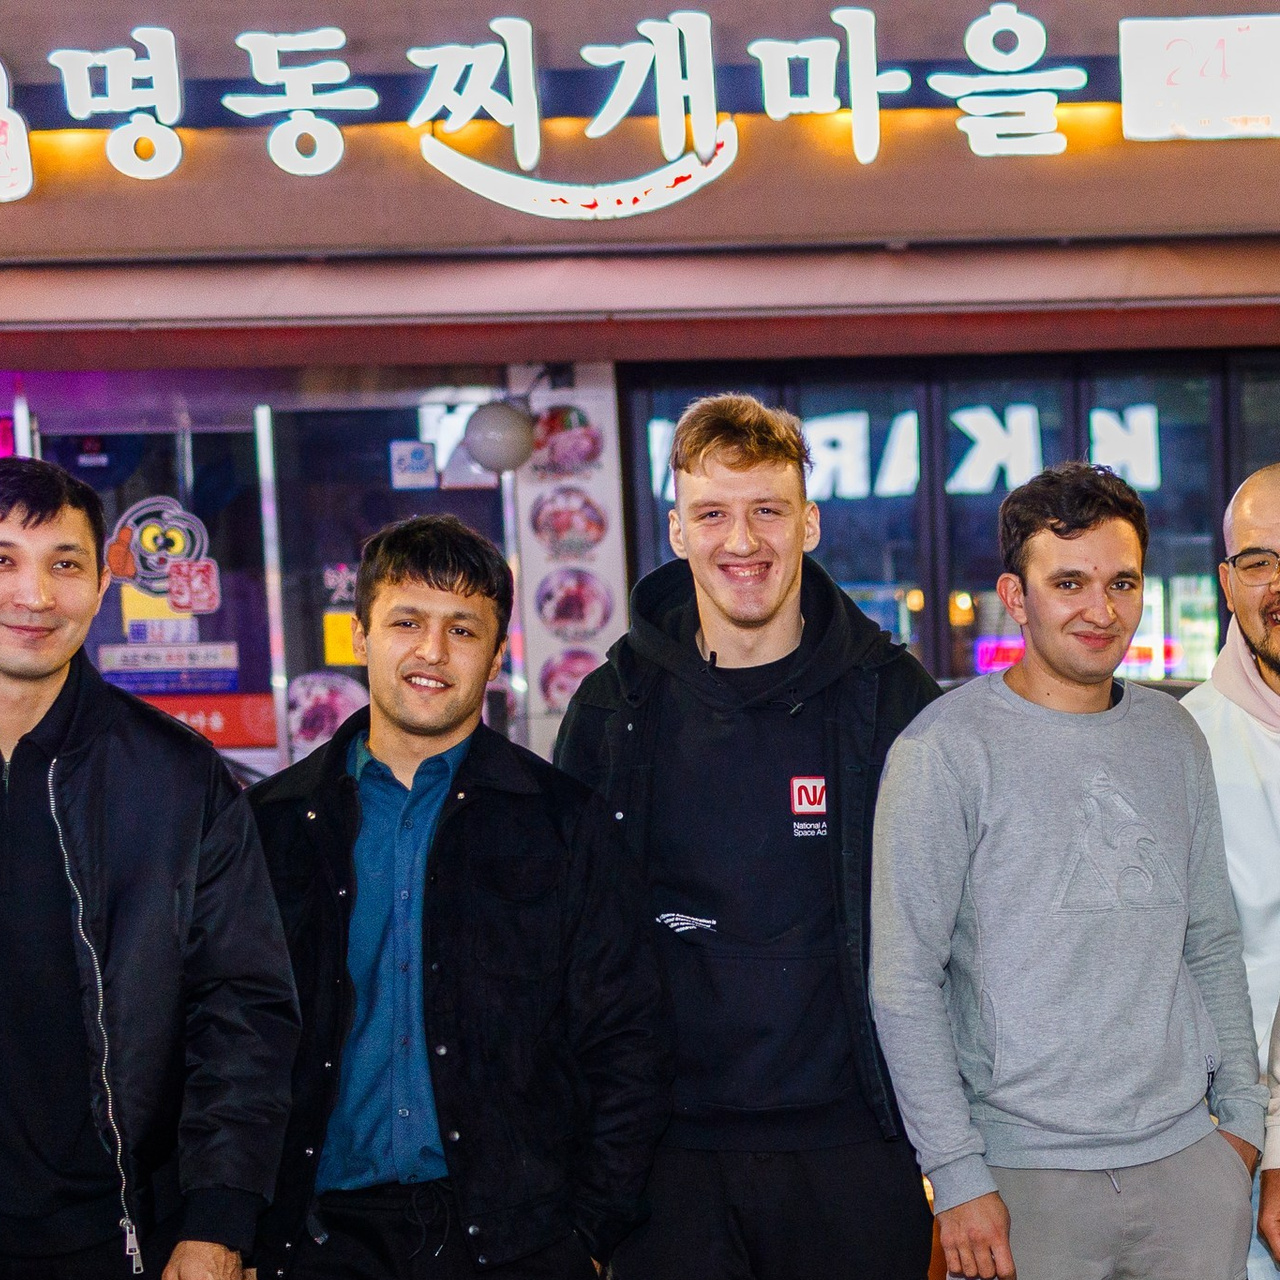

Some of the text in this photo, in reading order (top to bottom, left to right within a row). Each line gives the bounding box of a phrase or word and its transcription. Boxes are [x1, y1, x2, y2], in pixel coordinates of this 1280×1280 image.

[48, 3, 1088, 180] 명동찌개마을
[793, 821, 821, 830] National
[793, 829, 815, 838] Space
